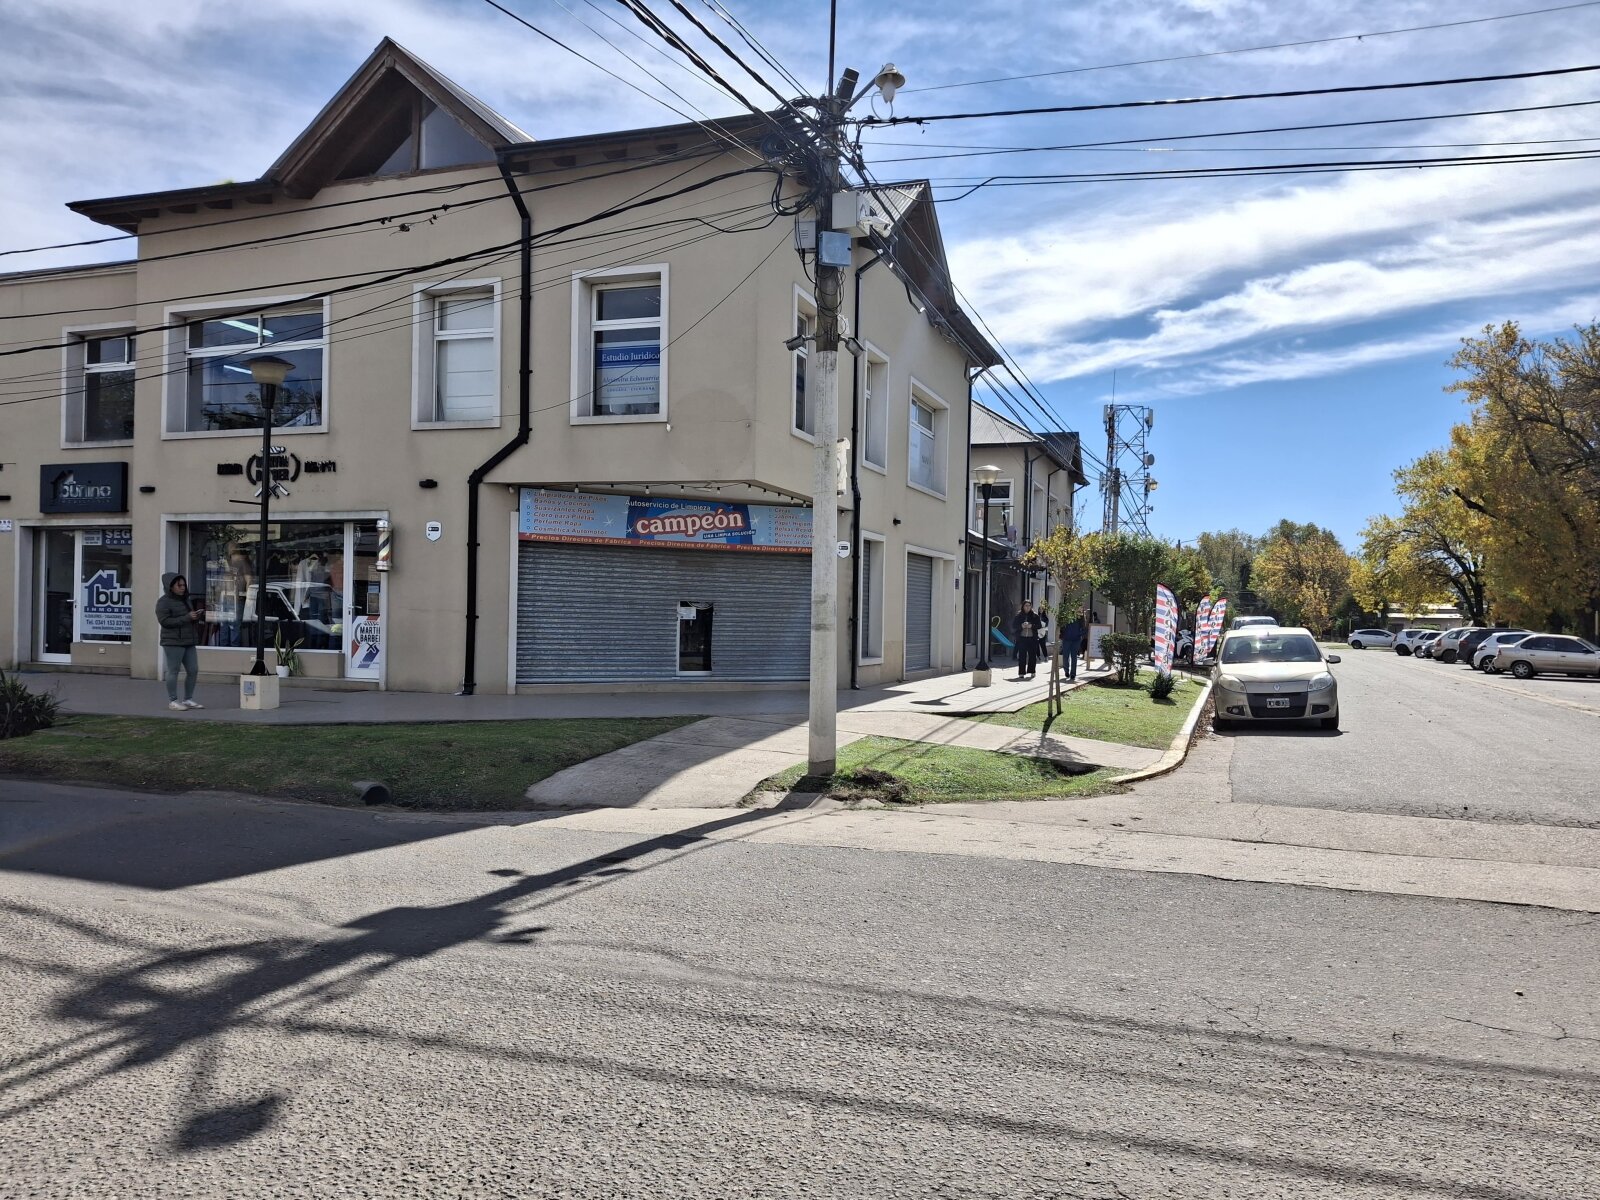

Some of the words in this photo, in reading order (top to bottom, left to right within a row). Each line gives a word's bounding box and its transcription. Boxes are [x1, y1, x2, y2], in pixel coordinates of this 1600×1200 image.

[602, 353, 629, 362] Estudio
[534, 505, 576, 513] Suavizantes
[625, 499, 671, 509] Autoservicio
[681, 503, 711, 511] Limpieza
[636, 509, 743, 535] campeón
[105, 529, 131, 539] SEG
[571, 528, 608, 536] Automotor
